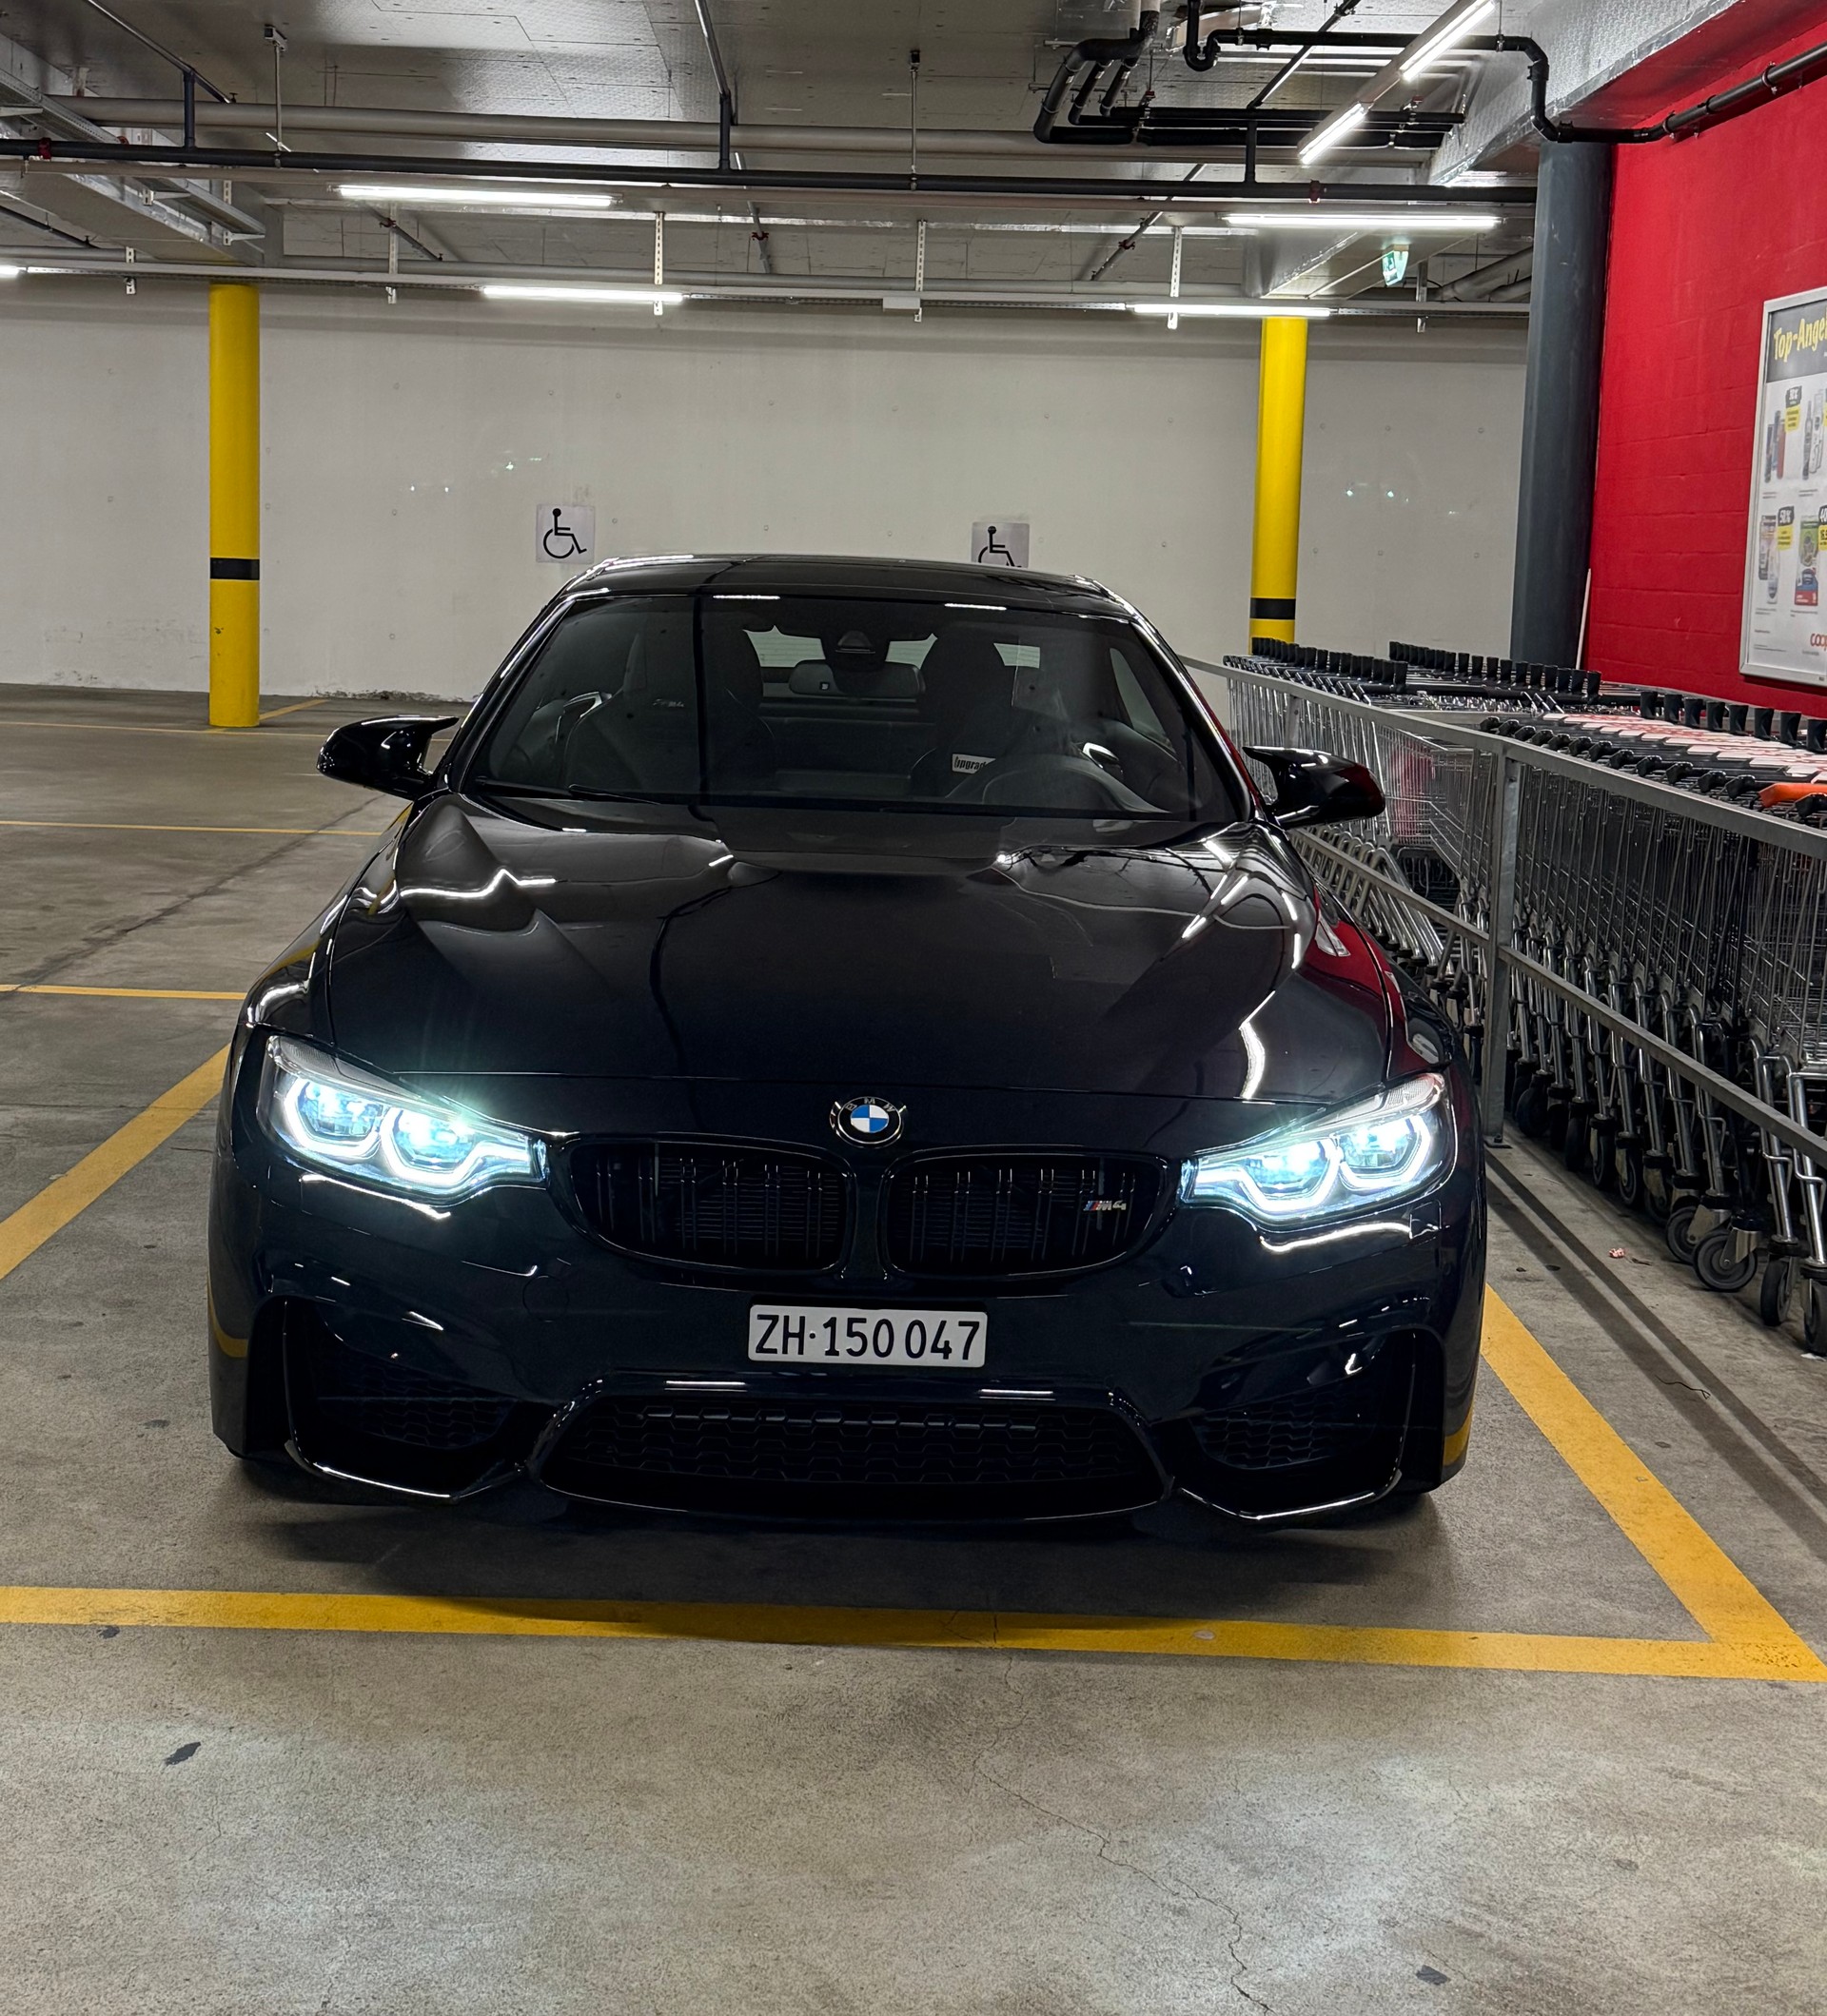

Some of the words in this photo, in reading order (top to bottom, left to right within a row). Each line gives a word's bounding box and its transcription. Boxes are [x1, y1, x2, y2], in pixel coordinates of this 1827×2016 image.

[1774, 306, 1827, 362] Top-Ange
[844, 1097, 897, 1113] BMW
[1094, 1200, 1127, 1211] M4
